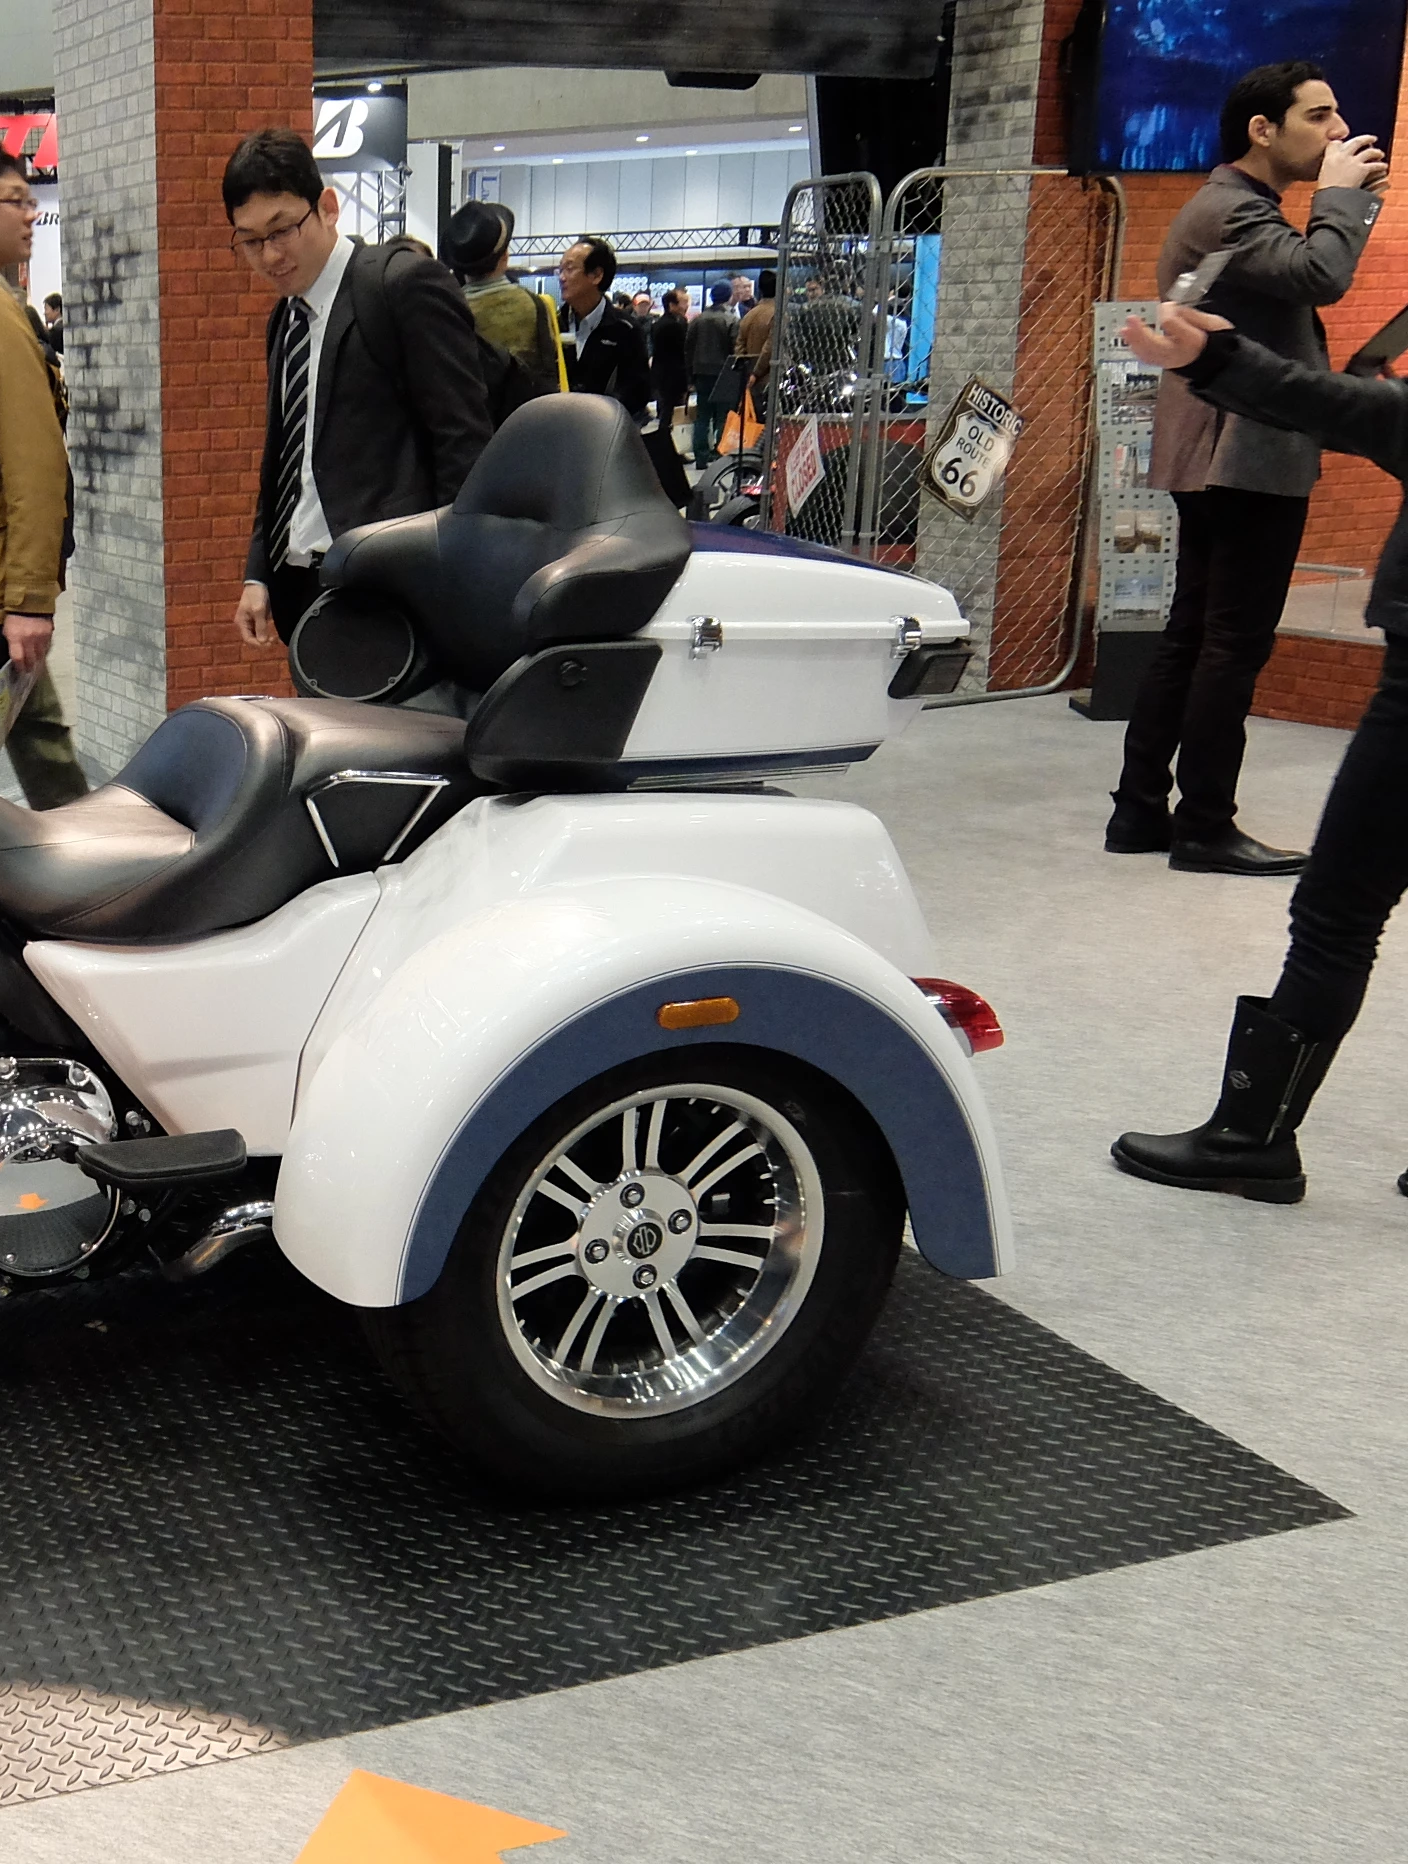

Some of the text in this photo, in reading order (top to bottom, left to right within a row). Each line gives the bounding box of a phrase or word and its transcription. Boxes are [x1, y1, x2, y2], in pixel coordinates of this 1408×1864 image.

[968, 383, 1023, 436] HISTORIC
[956, 437, 991, 469] ROUTE
[968, 425, 994, 451] OLD
[940, 457, 979, 497] 66
